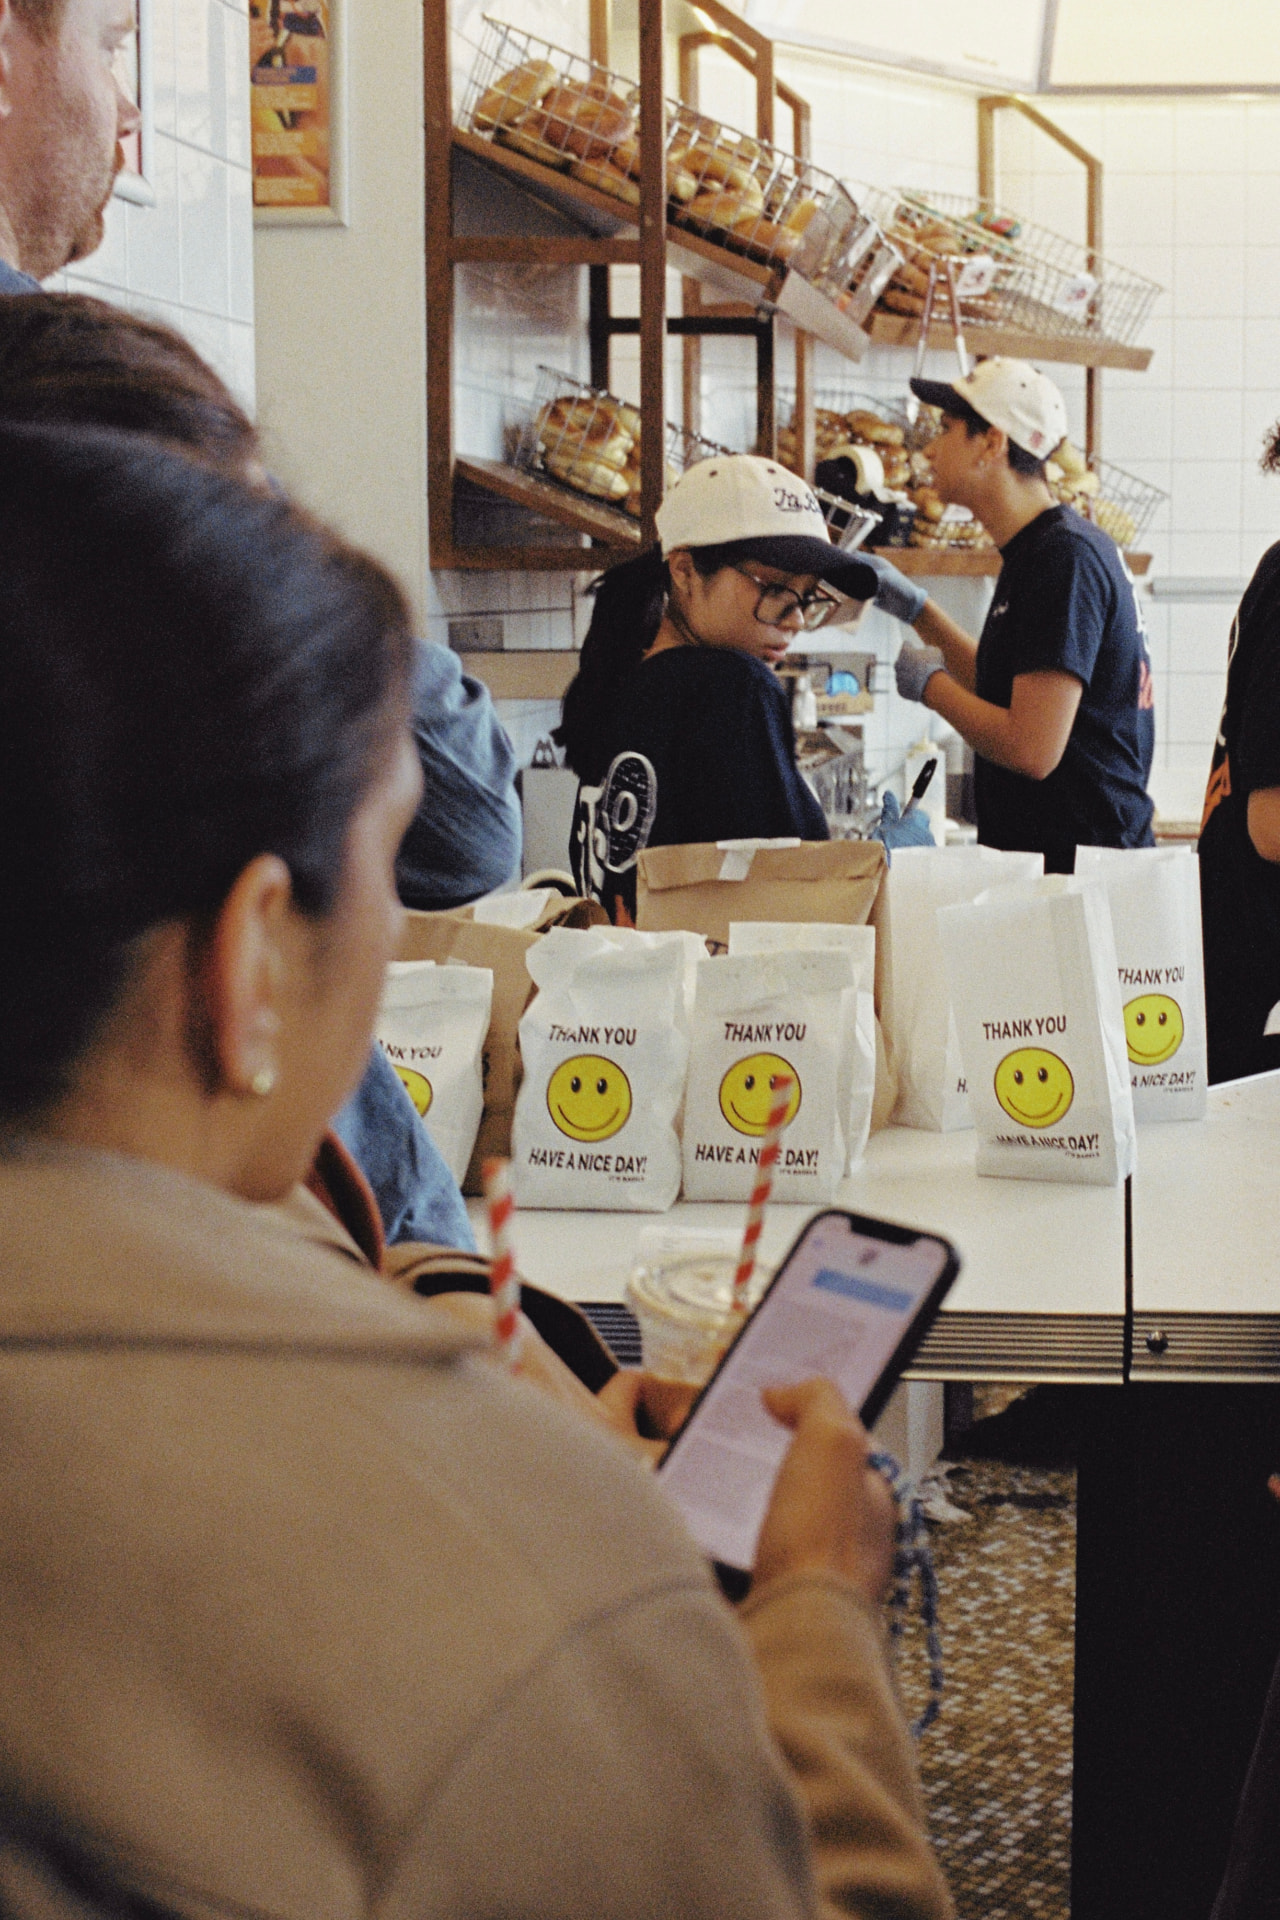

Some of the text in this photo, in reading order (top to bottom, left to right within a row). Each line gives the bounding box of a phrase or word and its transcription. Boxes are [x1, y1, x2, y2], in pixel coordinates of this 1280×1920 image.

[1118, 965, 1185, 984] THANK YOU
[549, 1025, 637, 1046] THANK YOU
[725, 1022, 807, 1042] THANK YOU
[982, 1015, 1066, 1040] THANK YOU
[1131, 1070, 1196, 1088] A NICE DAY!
[1067, 1134, 1099, 1151] DAY!
[528, 1148, 647, 1173] HAVE A NICE DAY!
[695, 1143, 818, 1167] HAVE A NE DAY!
